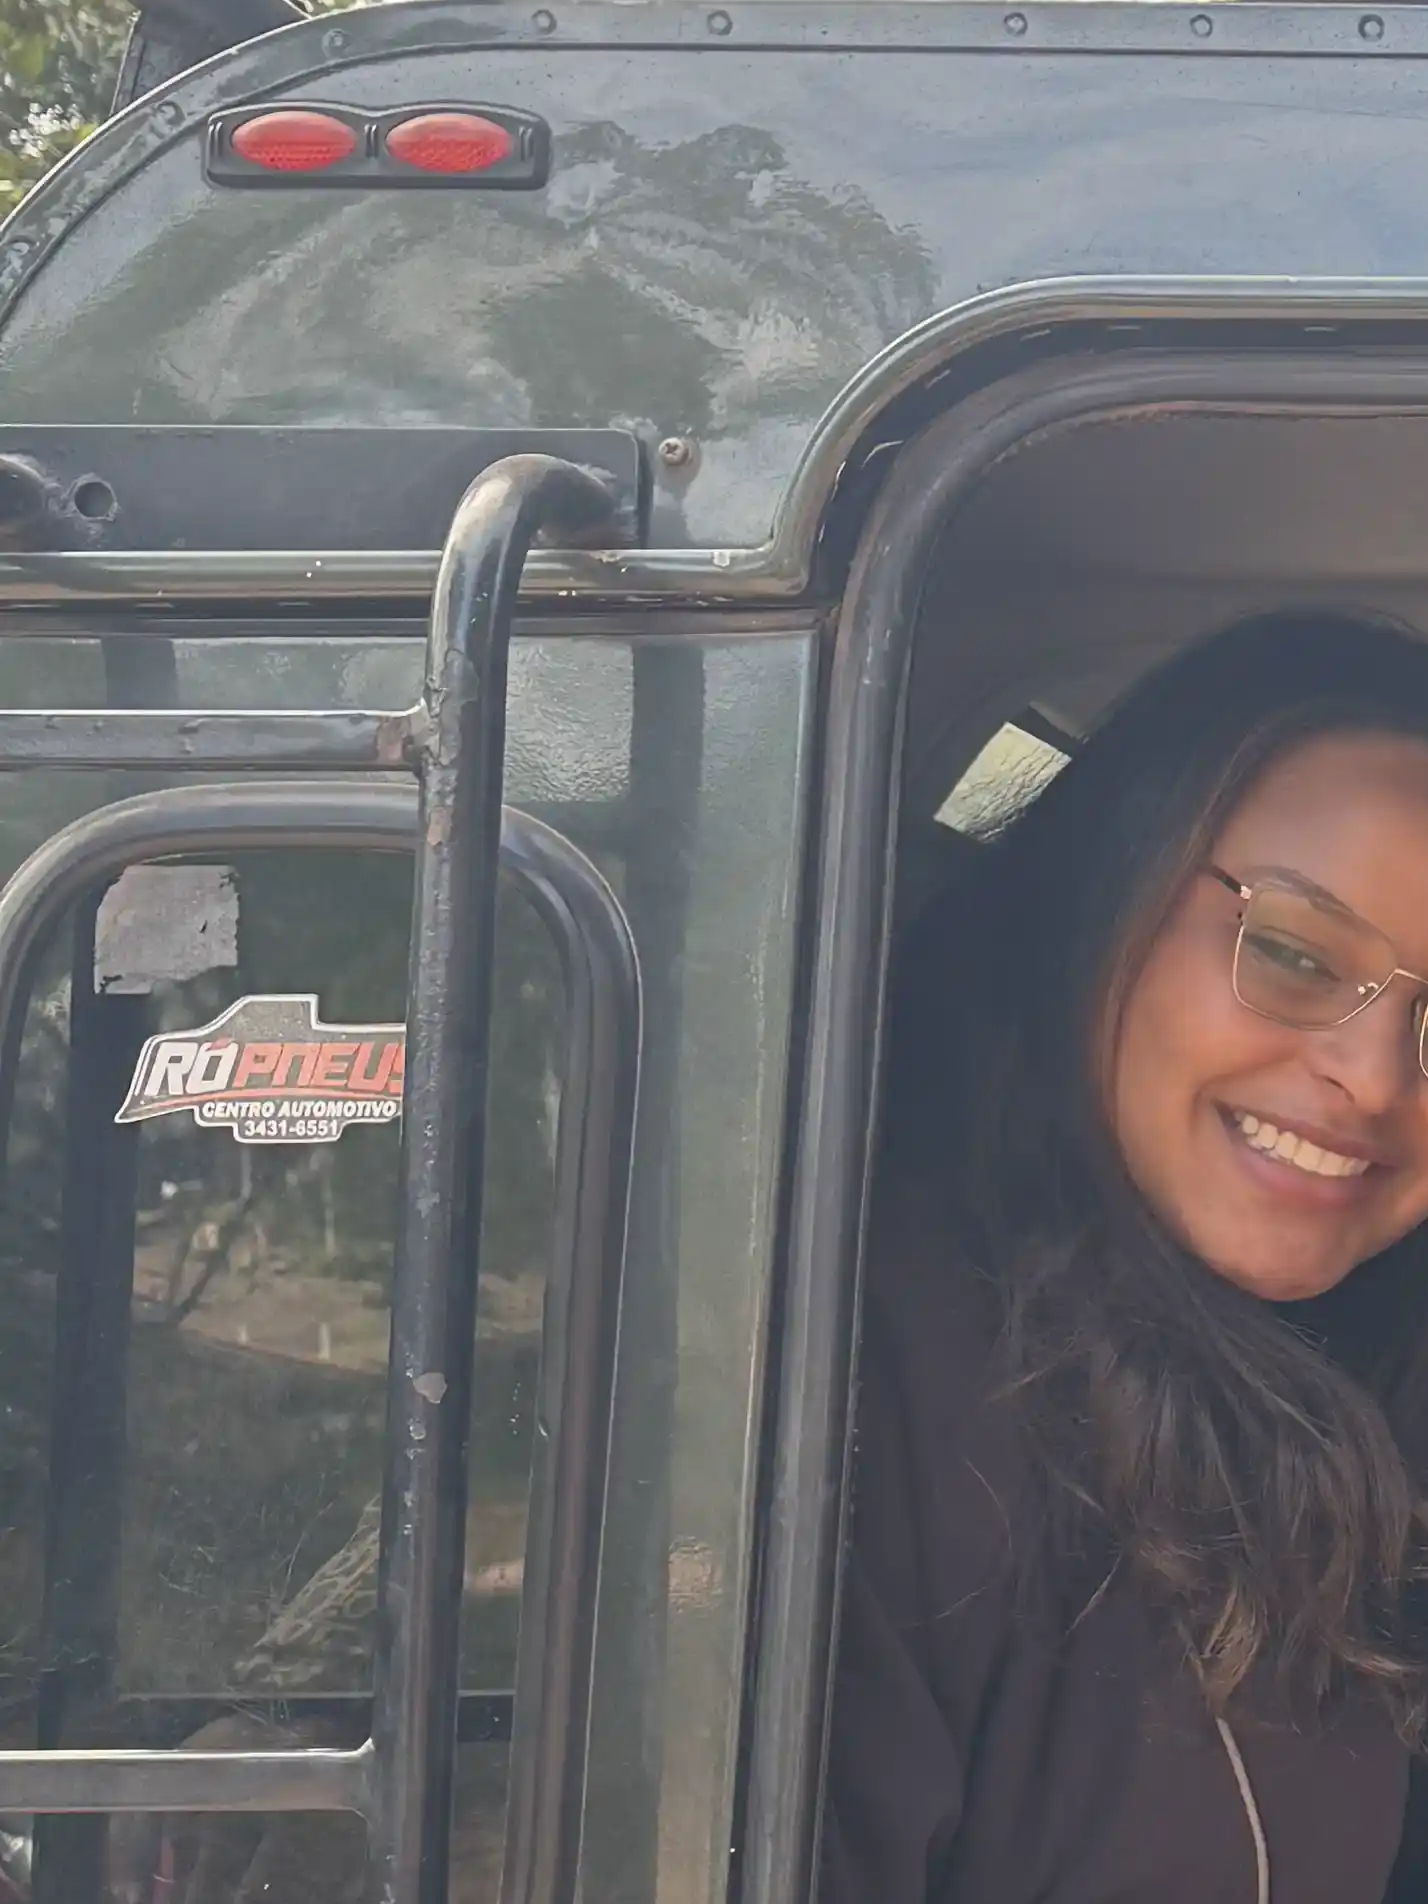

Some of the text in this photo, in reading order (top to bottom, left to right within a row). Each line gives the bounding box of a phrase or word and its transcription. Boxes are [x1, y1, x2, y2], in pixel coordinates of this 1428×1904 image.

[202, 1100, 398, 1118] CENTRO AUTOMOTIVO
[244, 1120, 338, 1137] 3431-6551
